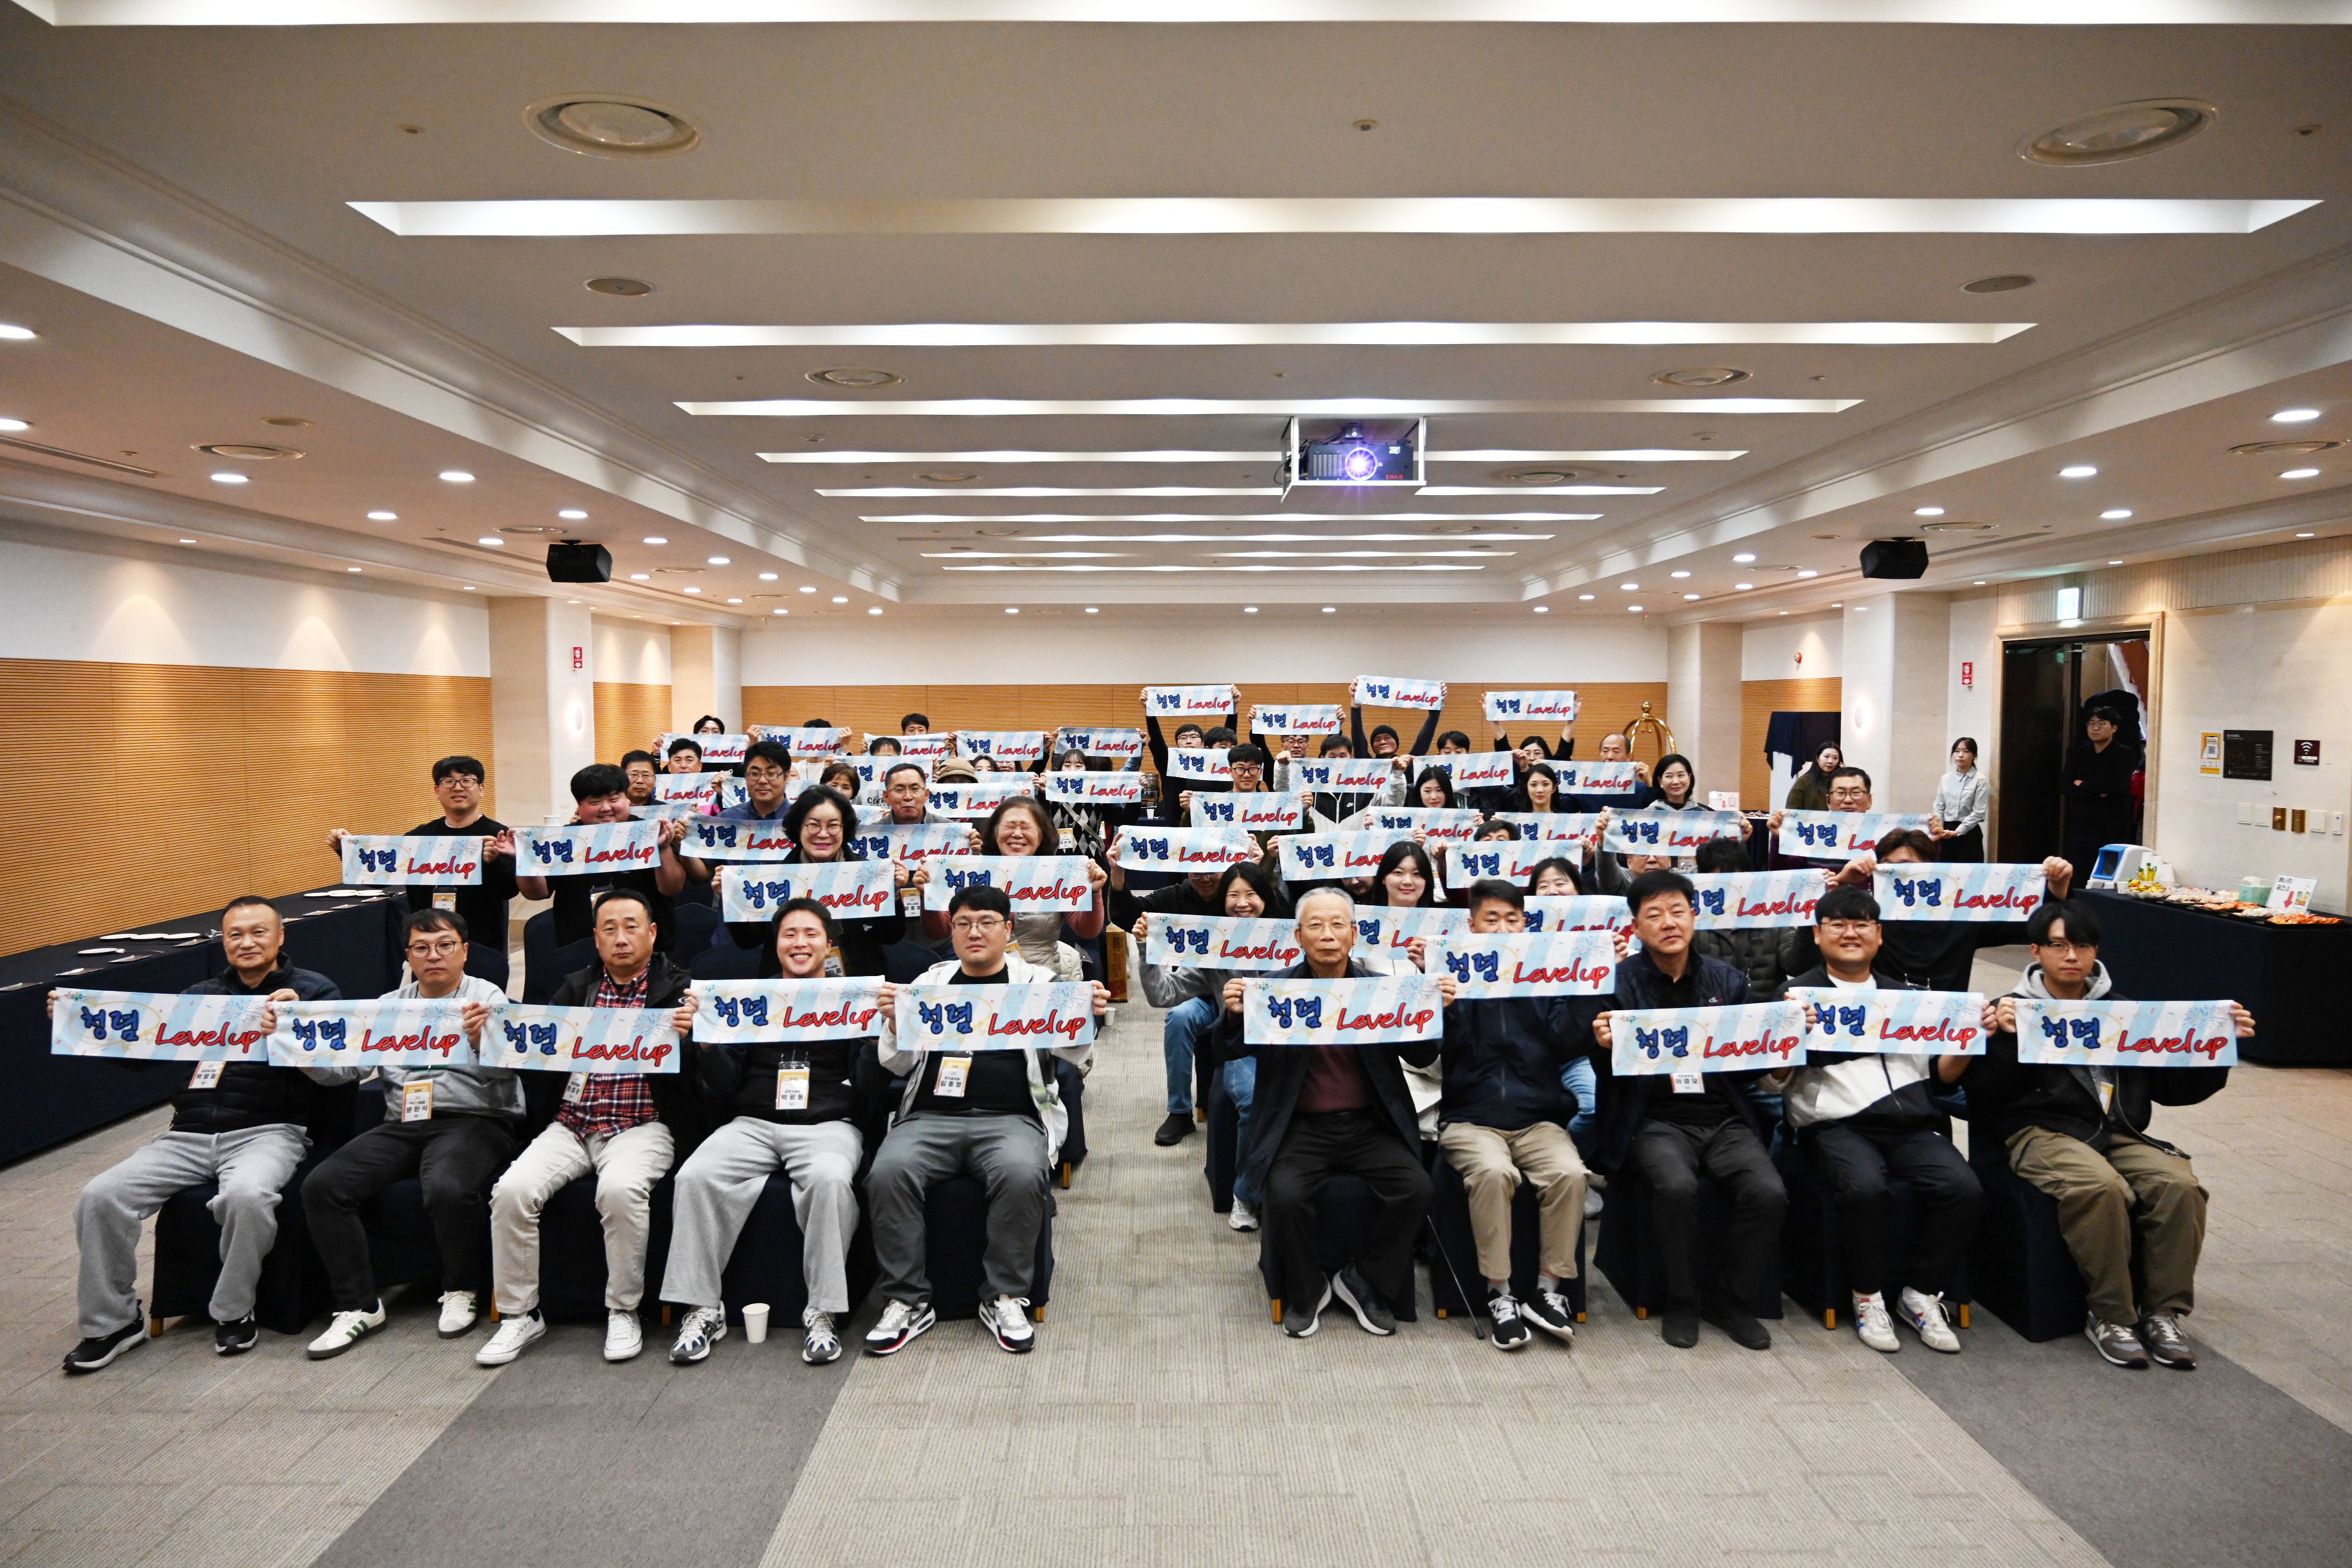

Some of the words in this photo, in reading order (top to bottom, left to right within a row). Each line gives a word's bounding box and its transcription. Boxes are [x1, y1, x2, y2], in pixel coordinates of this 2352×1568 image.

[1157, 693, 1181, 709] 청렴
[1366, 683, 1390, 699] 청렴
[1496, 699, 1520, 714] 청렴
[1262, 712, 1287, 728] 청렴
[966, 738, 991, 754] 청렴
[1065, 734, 1090, 749] 청렴
[1178, 754, 1204, 773] 청렴
[1211, 762, 1230, 775] Lev
[1301, 766, 1329, 784] 청렴
[1056, 777, 1084, 794] 청렴
[929, 791, 958, 810] 청렴
[1203, 801, 1234, 822] 청렴
[697, 824, 737, 848] 청렴
[1620, 819, 1659, 844] 청렴
[1796, 821, 1838, 847] 청렴
[1848, 834, 1877, 851] Lev
[359, 848, 397, 873] 청렴
[532, 839, 574, 864] 청렴
[1130, 837, 1169, 860] 청렴
[1296, 844, 1334, 868] 청렴
[1345, 851, 1384, 868] Leve
[1461, 852, 1500, 876] 청렴
[743, 879, 791, 909] 청렴
[1893, 877, 1942, 907] 청렴
[1165, 925, 1209, 955] 청렴
[1358, 919, 1380, 945] 렴
[1446, 950, 1499, 983] 청렴
[714, 995, 769, 1027] 청렴
[918, 1001, 973, 1035] 청렴
[1267, 995, 1322, 1029] 청렴
[1814, 1002, 1865, 1036] 청렴
[80, 1006, 140, 1042] 청렴
[292, 1018, 346, 1051] 청렴
[2041, 1015, 2101, 1050] 청렴
[504, 1019, 557, 1055] 청렴
[1635, 1025, 1689, 1059] 청렴
